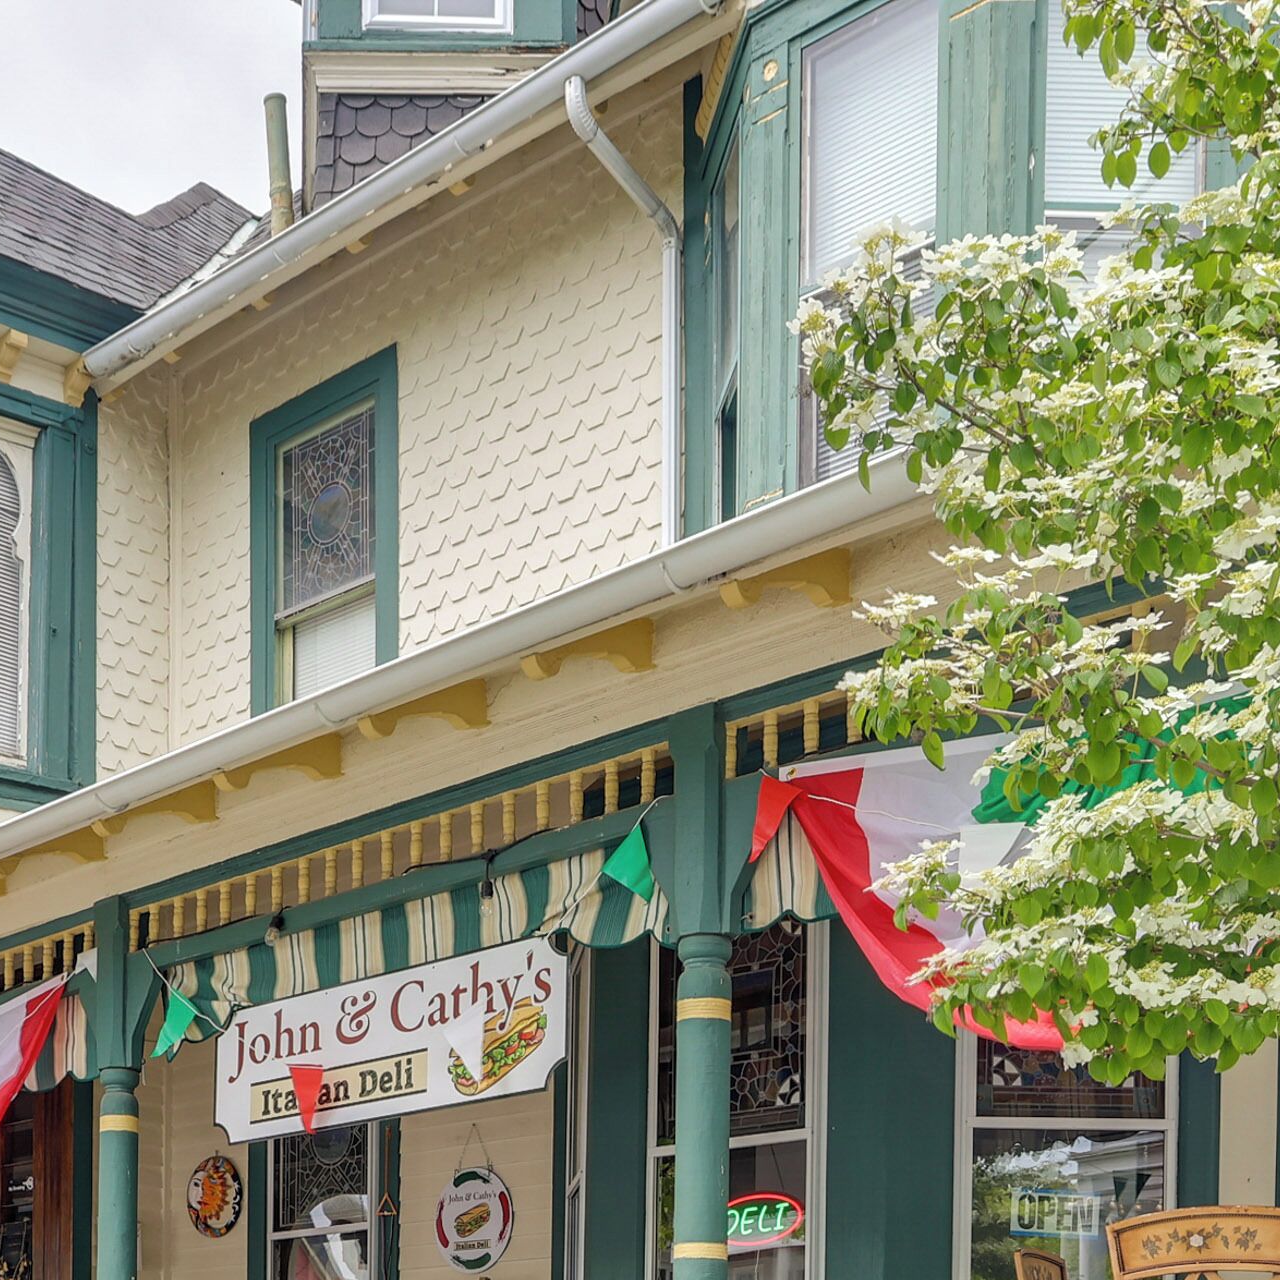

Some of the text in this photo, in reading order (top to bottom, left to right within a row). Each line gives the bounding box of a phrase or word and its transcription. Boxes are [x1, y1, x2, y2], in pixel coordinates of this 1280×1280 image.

[228, 951, 552, 1083] John & Cathy's
[261, 1057, 414, 1116] Itaan Deli
[448, 1190, 497, 1205] John & Cathy's
[1017, 1193, 1095, 1233] OPEN
[728, 1202, 790, 1236] DELI
[455, 1240, 489, 1250] Italian Deli
